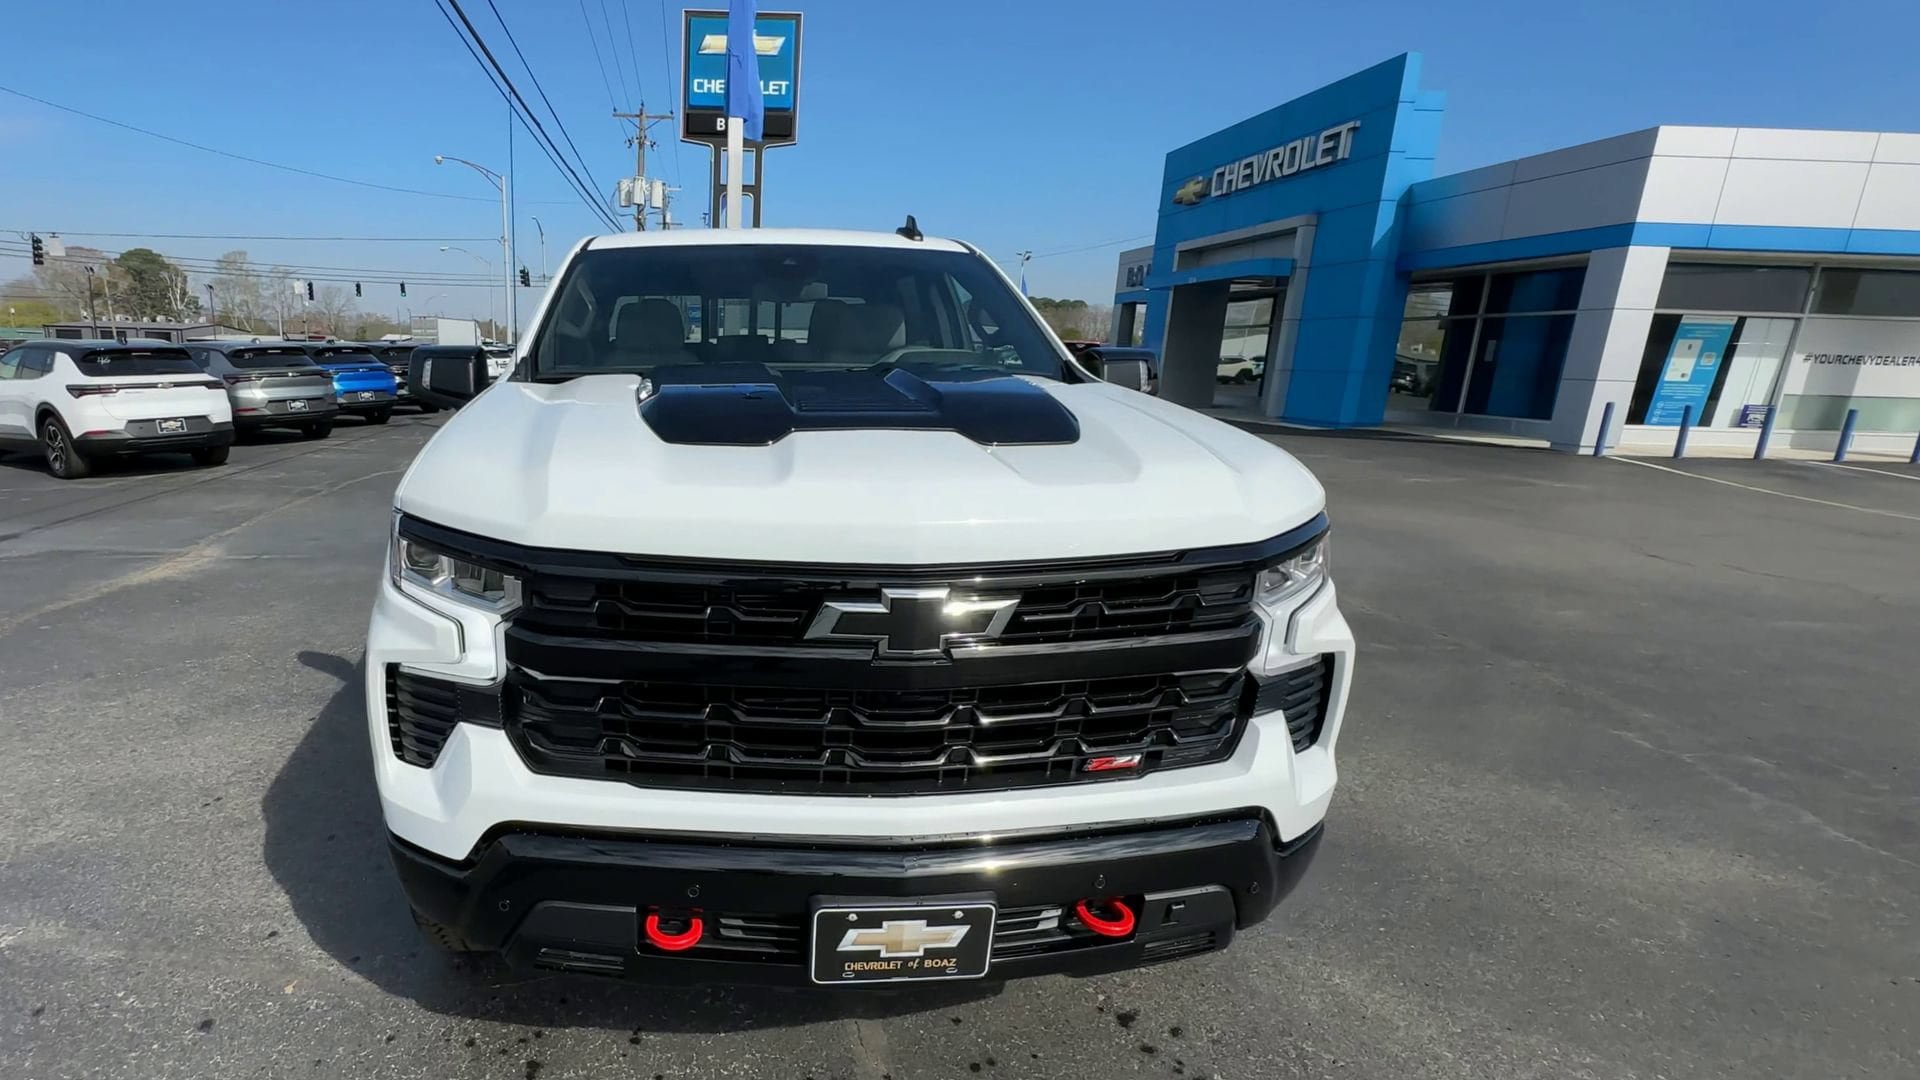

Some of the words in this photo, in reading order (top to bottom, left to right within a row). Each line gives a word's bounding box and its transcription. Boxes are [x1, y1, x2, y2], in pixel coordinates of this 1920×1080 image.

[693, 78, 789, 95] CHELET
[1210, 120, 1361, 198] CHEVROLET
[844, 960, 903, 971] CHEVROLET
[907, 958, 921, 969] of
[923, 958, 958, 968] BOAZ
